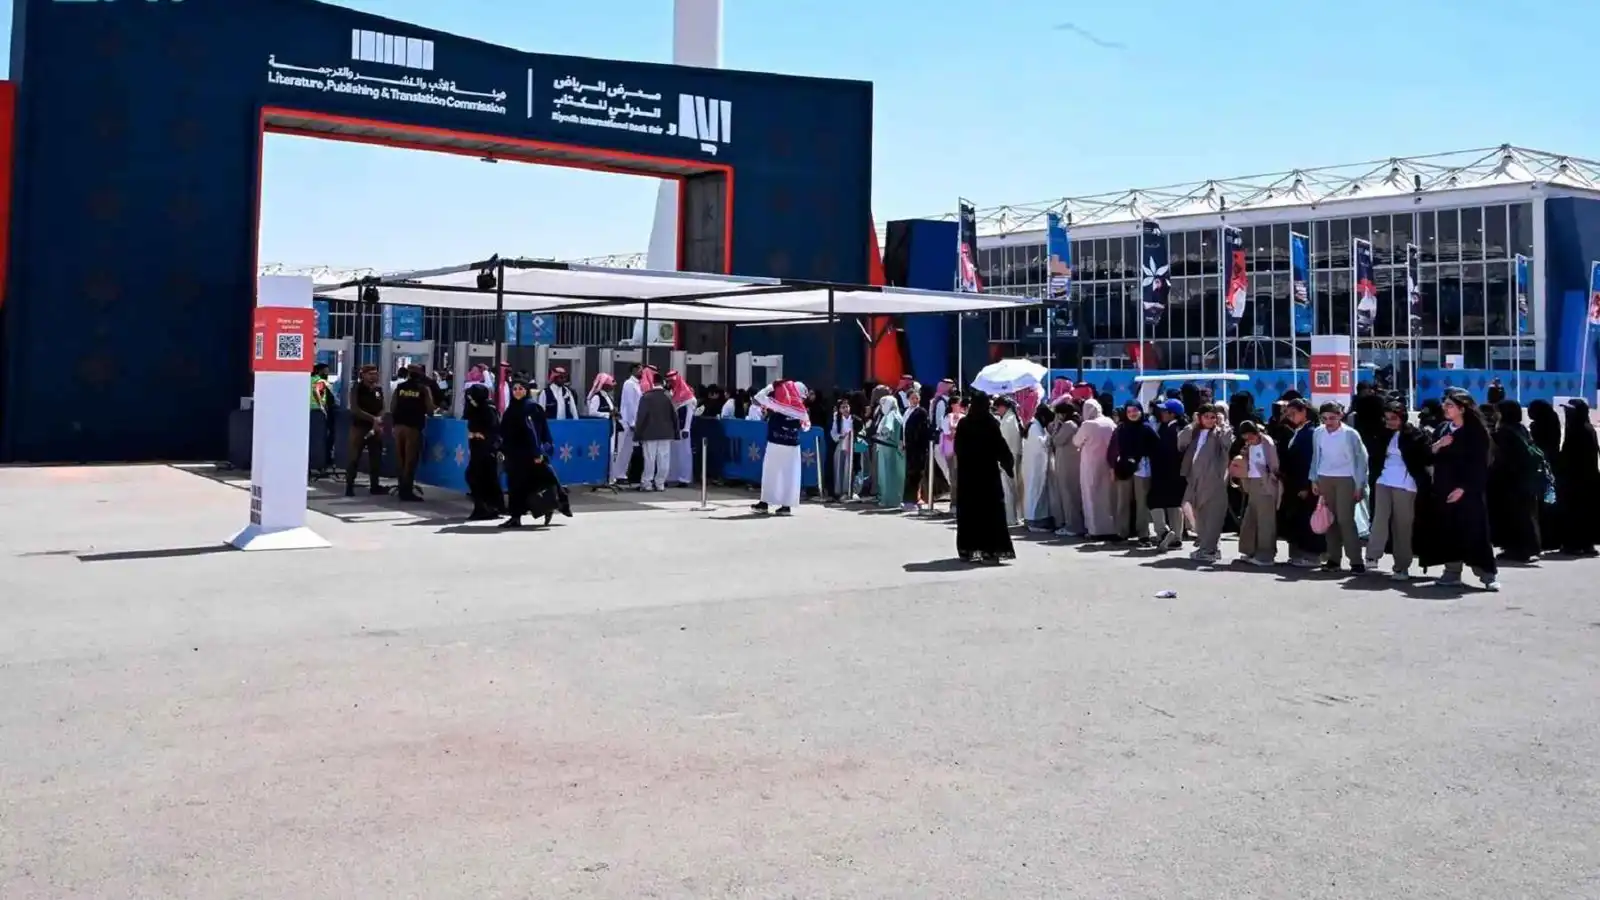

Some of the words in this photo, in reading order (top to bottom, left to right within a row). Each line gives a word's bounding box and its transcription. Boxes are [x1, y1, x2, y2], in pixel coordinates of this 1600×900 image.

[553, 75, 606, 93] الرياض
[381, 87, 390, 99] &
[390, 88, 446, 107] Translation
[446, 96, 506, 115] Commission
